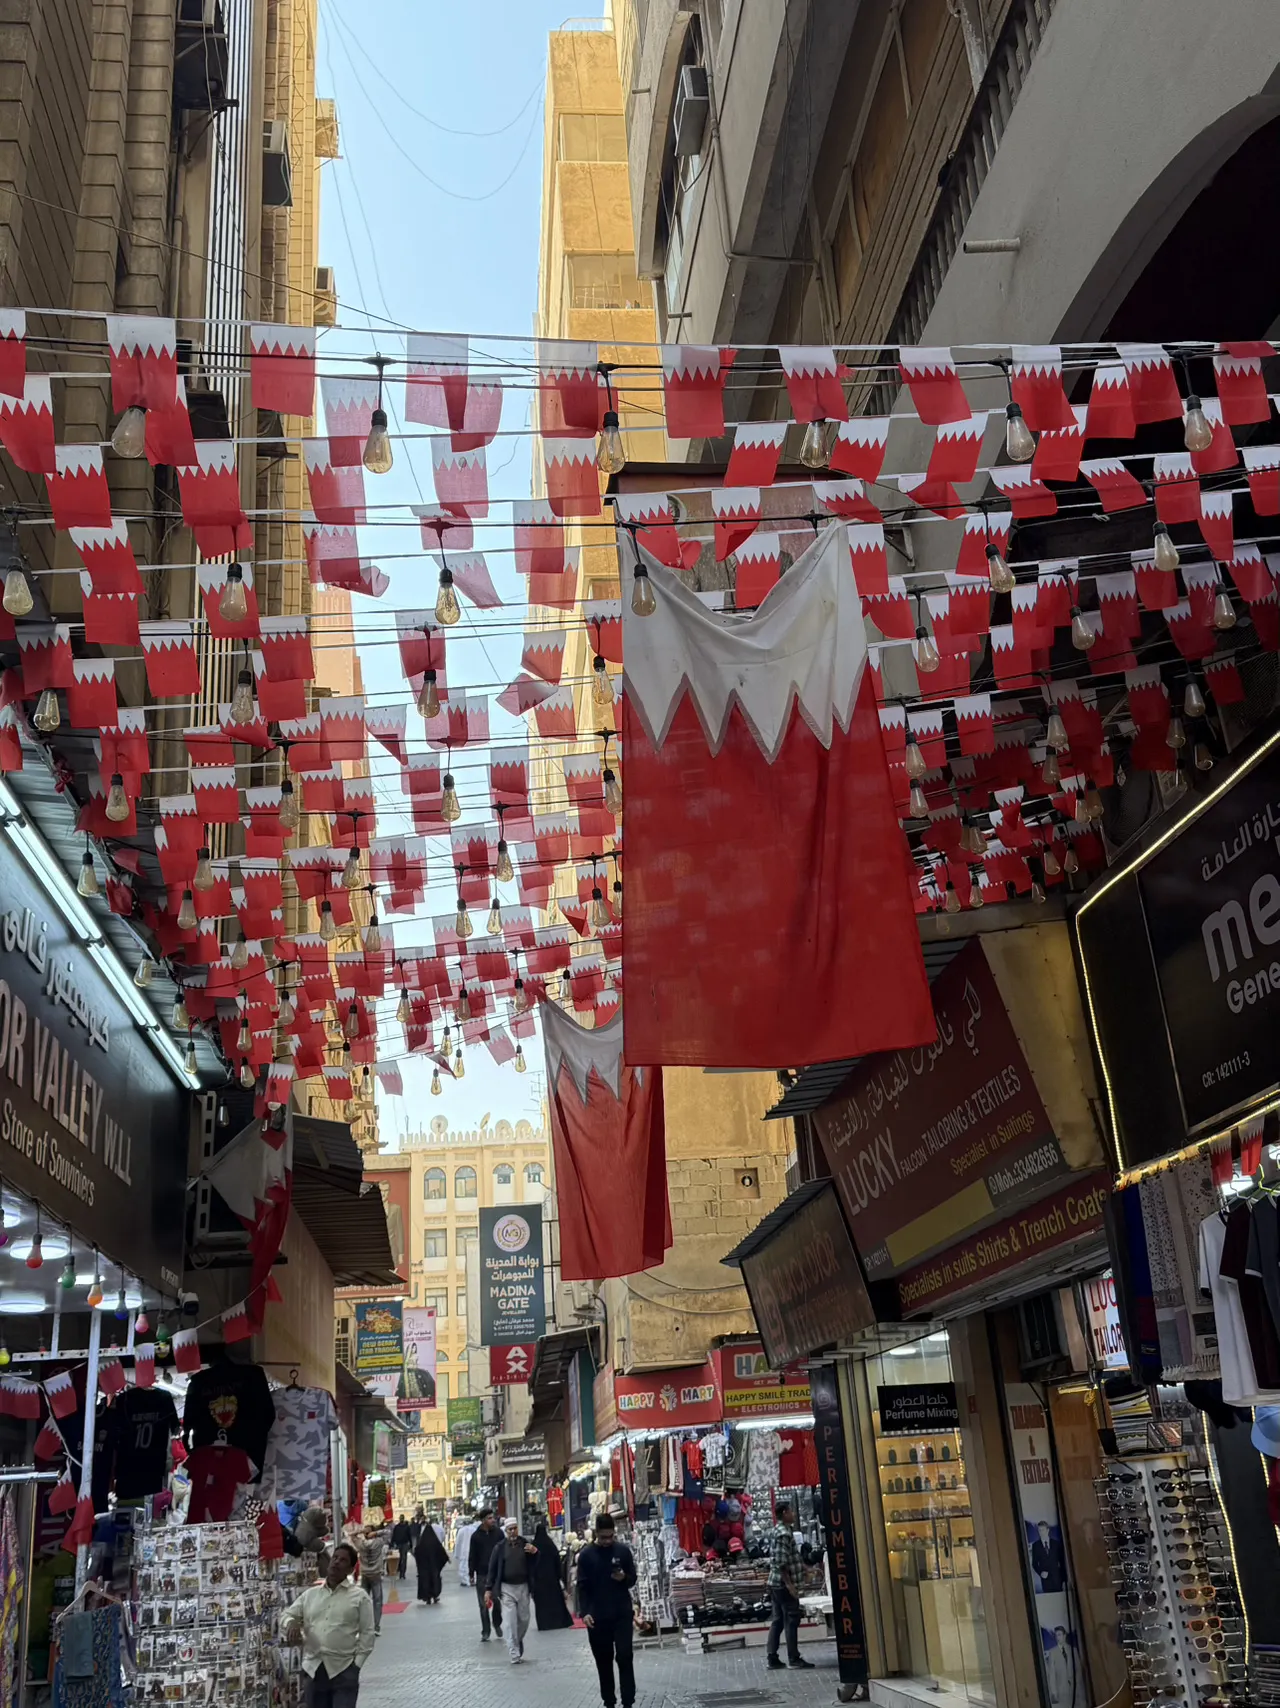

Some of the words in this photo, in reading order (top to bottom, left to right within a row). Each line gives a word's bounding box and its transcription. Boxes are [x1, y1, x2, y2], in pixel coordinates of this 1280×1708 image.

[1200, 822, 1253, 882] العامة
[1215, 1051, 1251, 1084] 142111-3
[33, 1017, 103, 1154] VALLEY
[2, 1099, 33, 1159] Store
[36, 1131, 48, 1168] of
[838, 1127, 902, 1217] LUCKY
[900, 1145, 929, 1178] FALCON
[922, 1105, 970, 1156] TAILORING
[964, 1100, 977, 1124] &
[971, 1064, 1022, 1119] TEXTILES
[950, 1139, 990, 1177] Specialist
[989, 1134, 999, 1150] in
[997, 1109, 1035, 1140] Suitings
[485, 1255, 517, 1270] المدينة
[518, 1254, 539, 1268] بوابة
[899, 1269, 943, 1304] Specialists
[941, 1261, 953, 1282] in
[953, 1252, 977, 1278] suits
[976, 1236, 1010, 1266] Shirts
[1009, 1226, 1021, 1251] &
[1019, 1205, 1066, 1247] Trench
[491, 1269, 535, 1282] للمجوهرات
[490, 1285, 536, 1298] MADINA
[497, 1297, 530, 1309] GATE
[734, 1353, 771, 1378] HA
[618, 1392, 655, 1410] HAPPY
[681, 1385, 714, 1403] MART
[726, 1391, 757, 1403] HAPPY
[758, 1389, 786, 1400] SMILE
[892, 1394, 925, 1409] العطور
[926, 1393, 949, 1405] خلط
[741, 1402, 800, 1413] ELECTRONICS
[885, 1408, 925, 1420] Perfume
[926, 1407, 958, 1419] Mixing
[134, 1423, 154, 1449] 10
